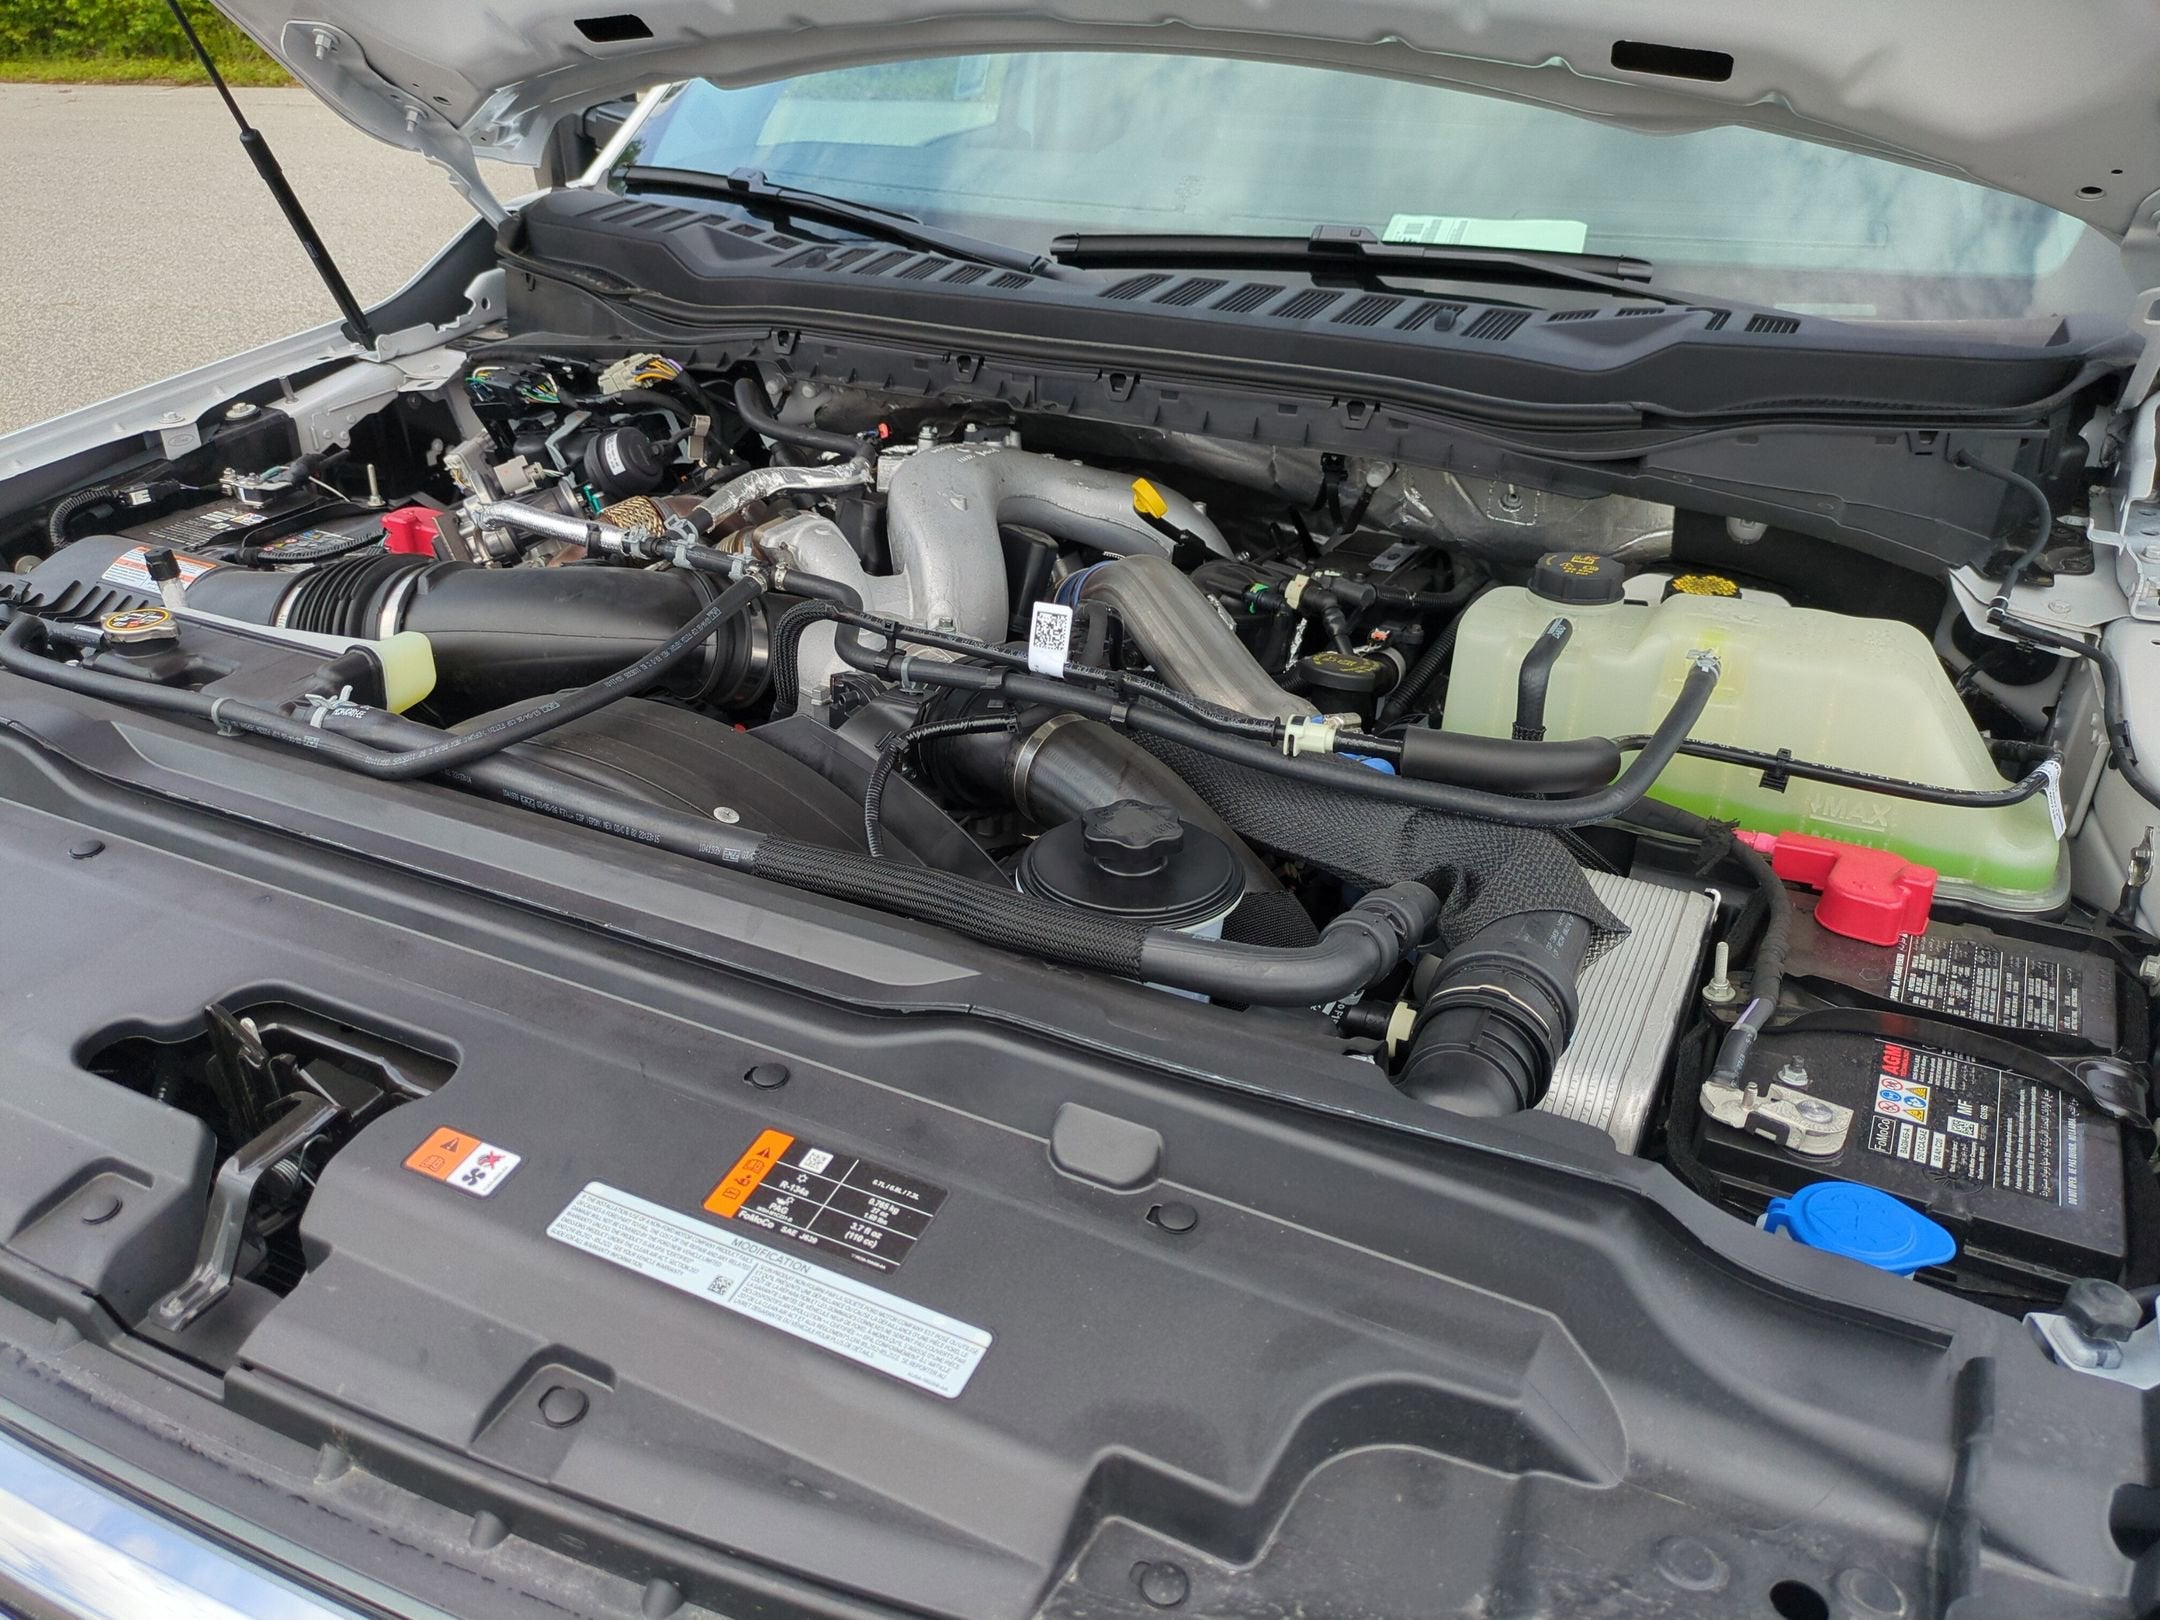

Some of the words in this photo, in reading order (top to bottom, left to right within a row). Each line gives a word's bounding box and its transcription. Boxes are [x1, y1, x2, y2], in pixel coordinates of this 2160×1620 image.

[1881, 1043, 1902, 1075] AGM
[1955, 1098, 1974, 1116] MF
[1873, 1115, 1890, 1152] FoMoCo
[777, 1180, 811, 1196] R-134a
[768, 1202, 789, 1215] PAG
[886, 1205, 901, 1215] kg
[737, 1211, 776, 1228] FoMoCo
[779, 1225, 798, 1237] SAE
[797, 1231, 819, 1244] J639
[849, 1222, 864, 1232] 3.7
[869, 1230, 883, 1239] oz
[843, 1230, 864, 1243] (110
[862, 1237, 878, 1249] cc)
[732, 1237, 810, 1274] MODIFICATION
